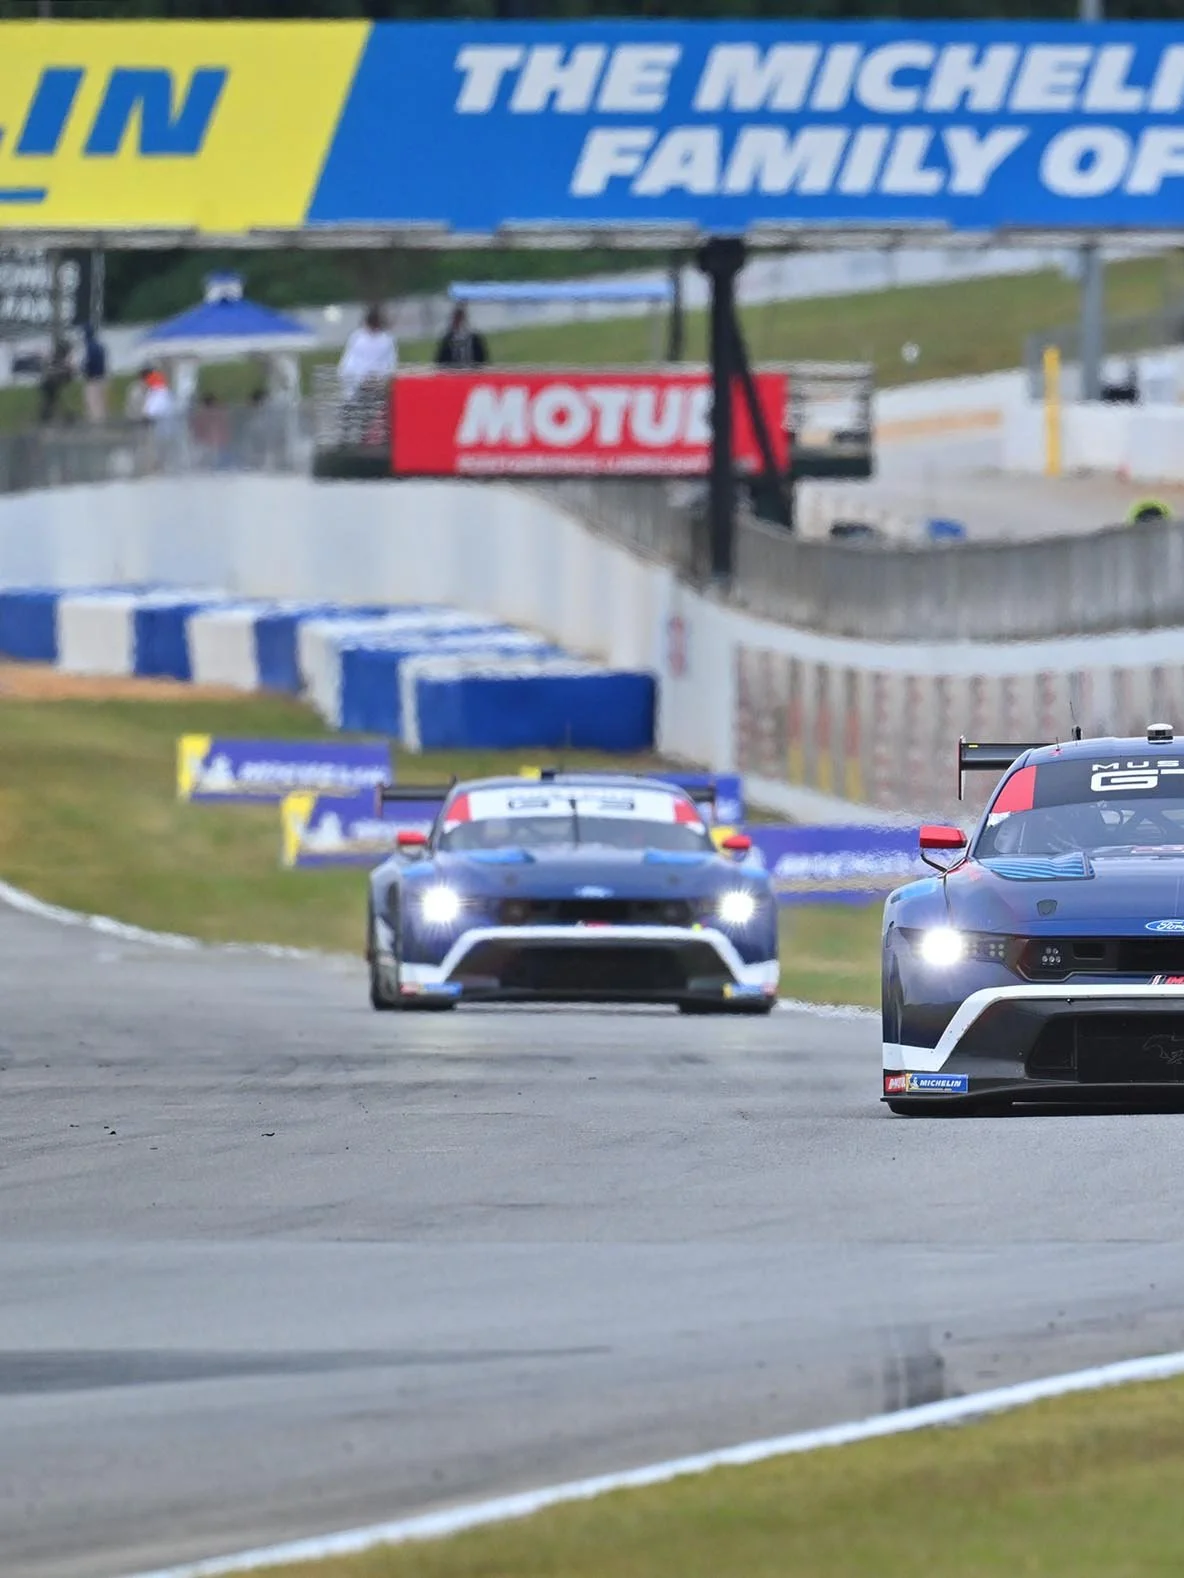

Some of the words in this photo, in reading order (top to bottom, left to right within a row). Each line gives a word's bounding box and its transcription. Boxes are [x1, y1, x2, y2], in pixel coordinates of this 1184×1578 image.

[0, 65, 230, 157] IN
[455, 44, 682, 114] THE
[569, 125, 1029, 197] FAMILY
[919, 1079, 962, 1087] MICHELIN
